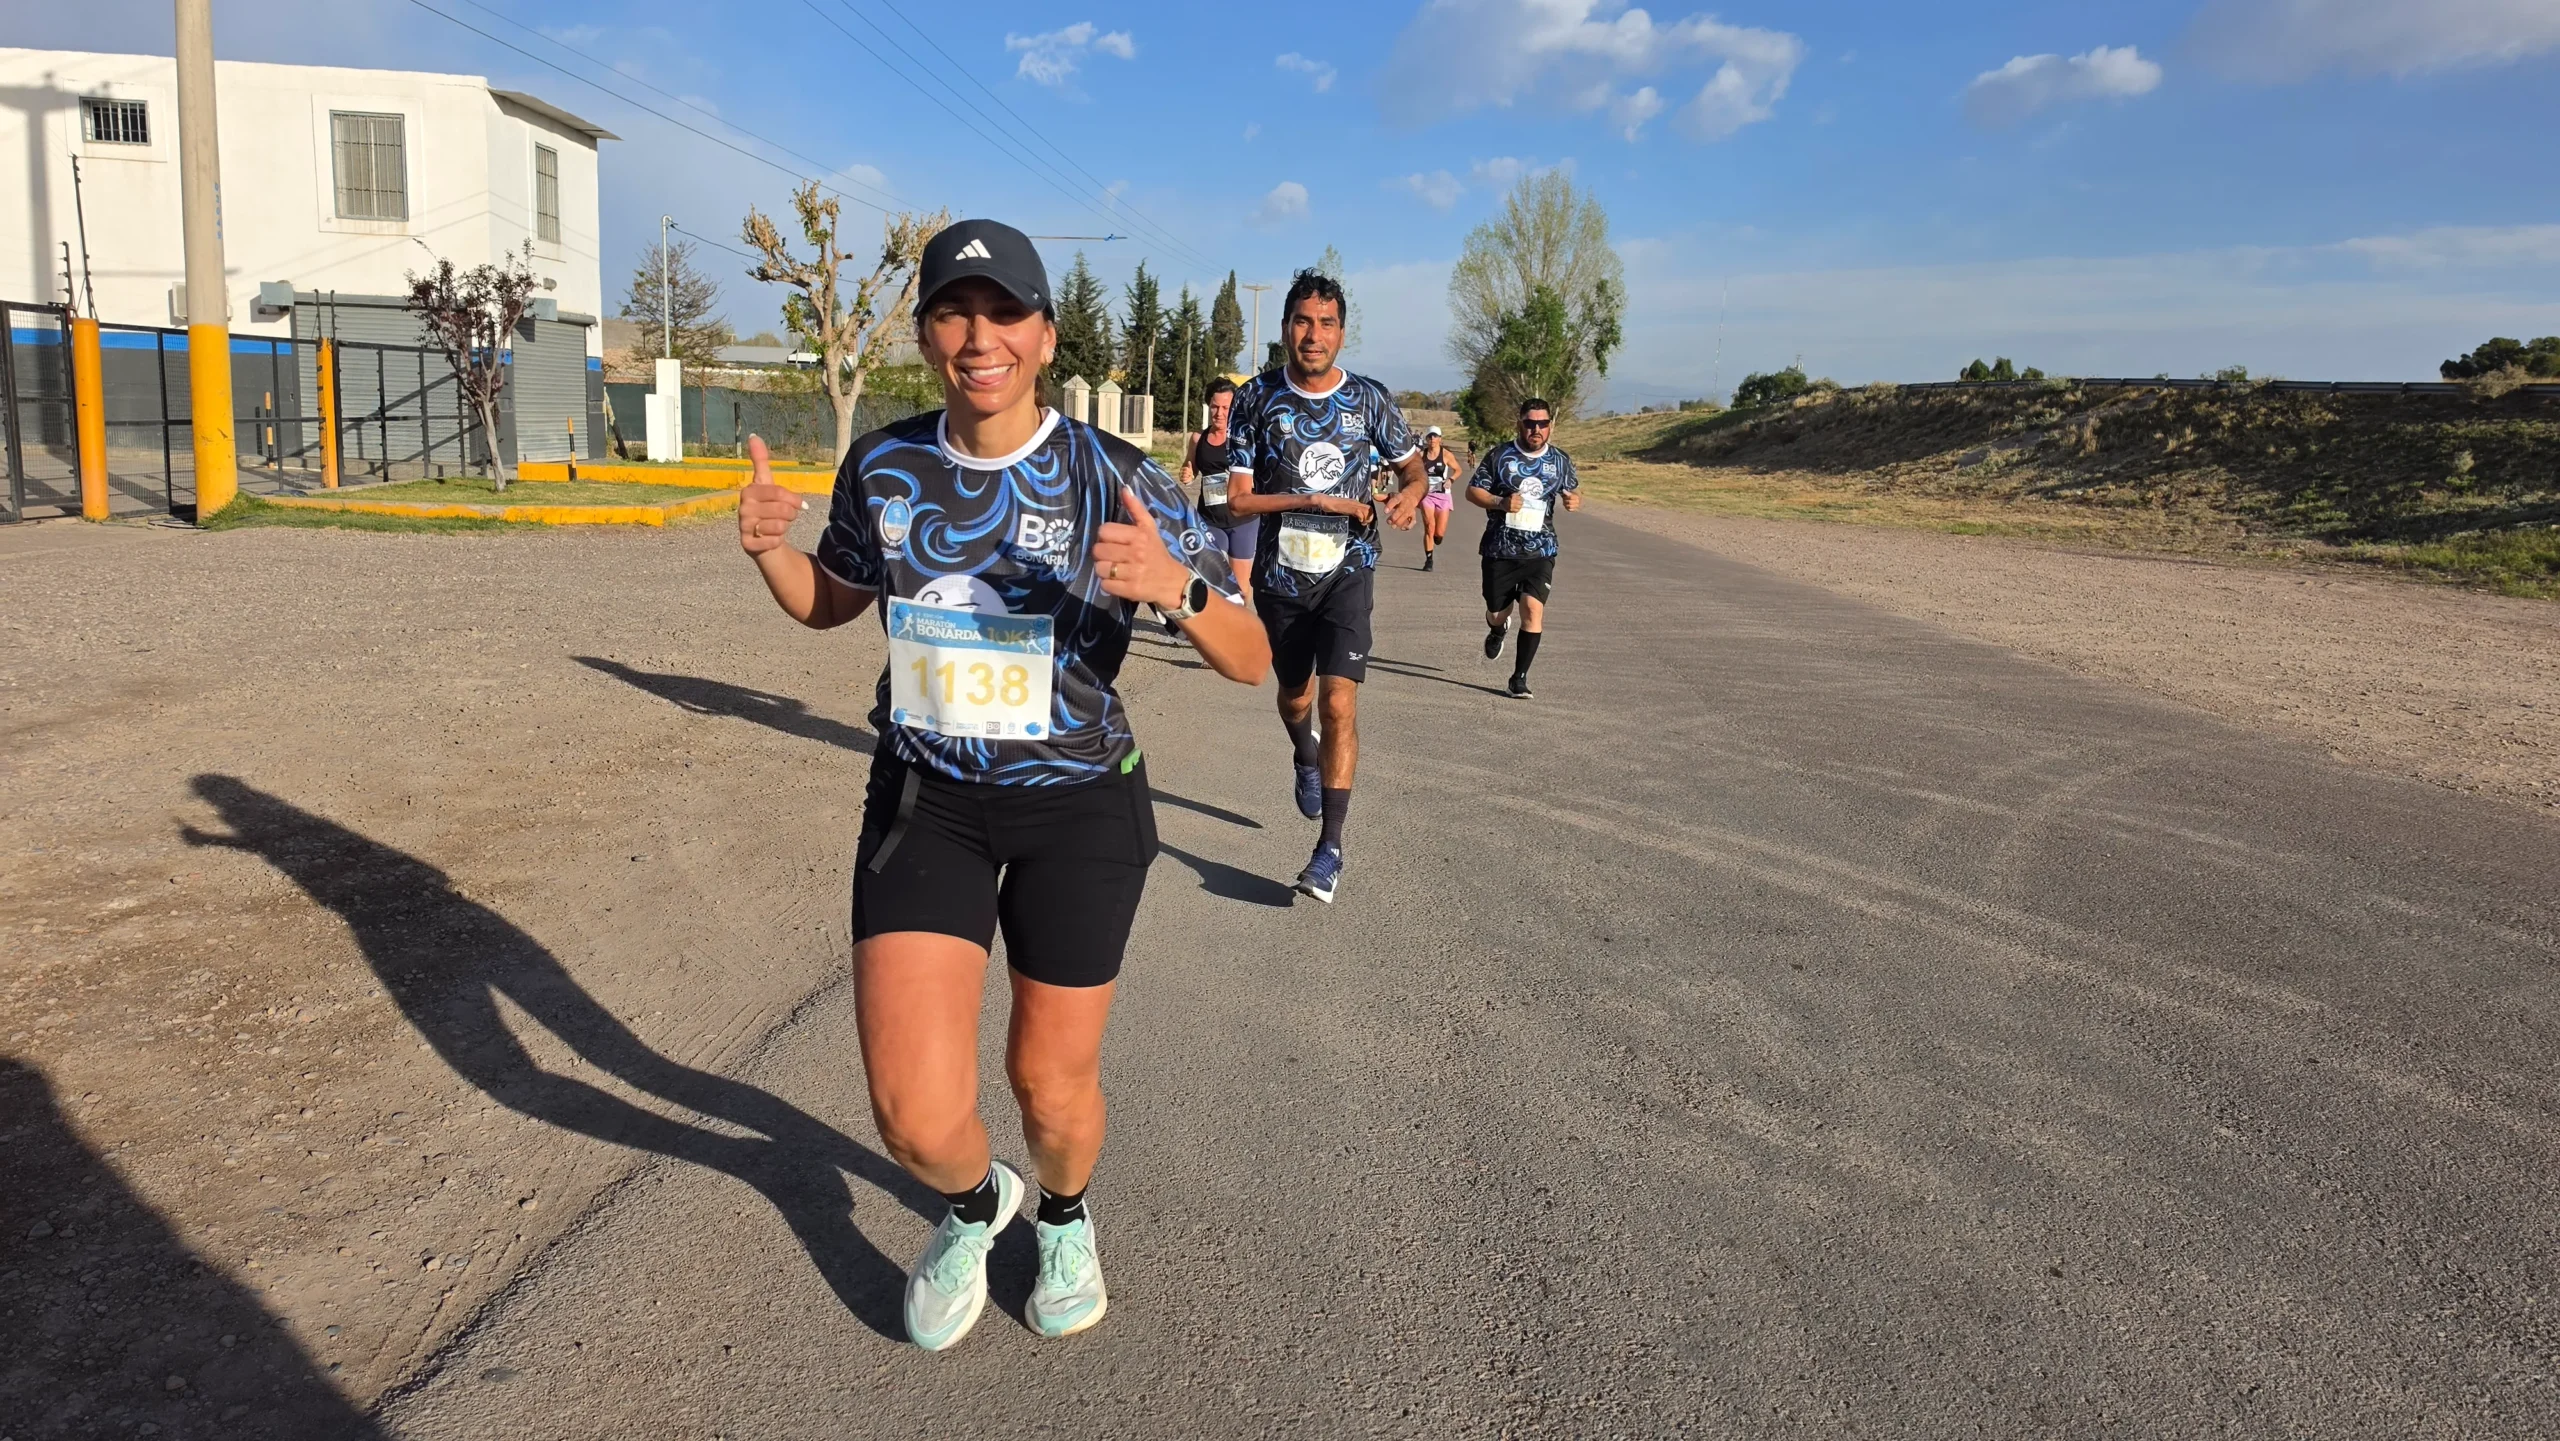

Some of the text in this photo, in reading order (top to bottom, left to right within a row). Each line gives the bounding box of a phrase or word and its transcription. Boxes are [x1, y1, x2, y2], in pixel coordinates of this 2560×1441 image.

[916, 617, 957, 629] MARATÓN
[916, 624, 983, 641] BONARDA
[987, 627, 1026, 647] 10K
[911, 655, 1029, 707] 1138
